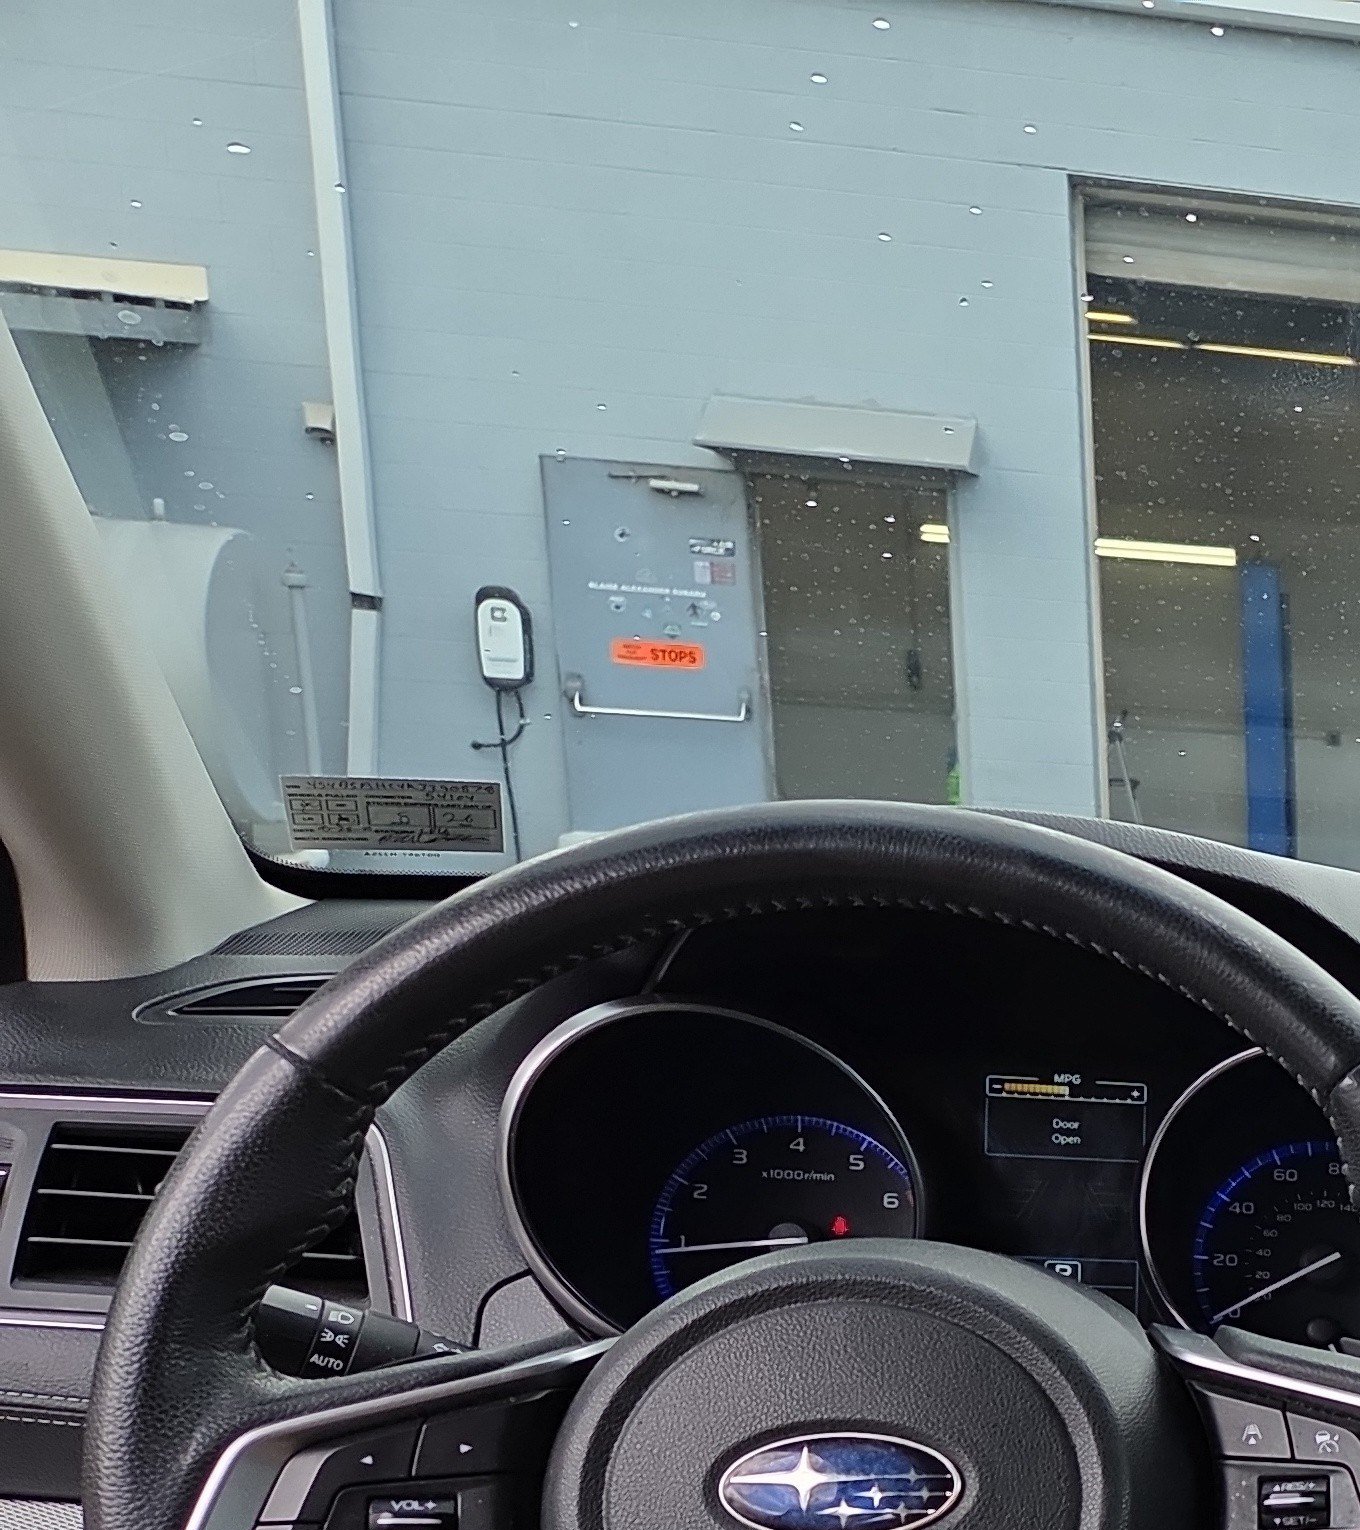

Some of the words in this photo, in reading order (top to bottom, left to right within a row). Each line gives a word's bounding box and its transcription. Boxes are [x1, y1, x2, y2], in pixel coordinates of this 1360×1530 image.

[650, 648, 697, 664] STOPS
[1053, 1073, 1082, 1085] MPG
[1052, 1118, 1080, 1130] Door
[789, 1138, 806, 1152] 4
[1051, 1133, 1081, 1146] Open
[733, 1150, 748, 1164] 3
[849, 1155, 865, 1170] 5
[1273, 1169, 1298, 1182] 60
[693, 1184, 708, 1199] 2
[883, 1193, 899, 1208] 6
[1229, 1202, 1254, 1214] 40
[1213, 1254, 1238, 1266] 20
[309, 1353, 344, 1371] AUTO
